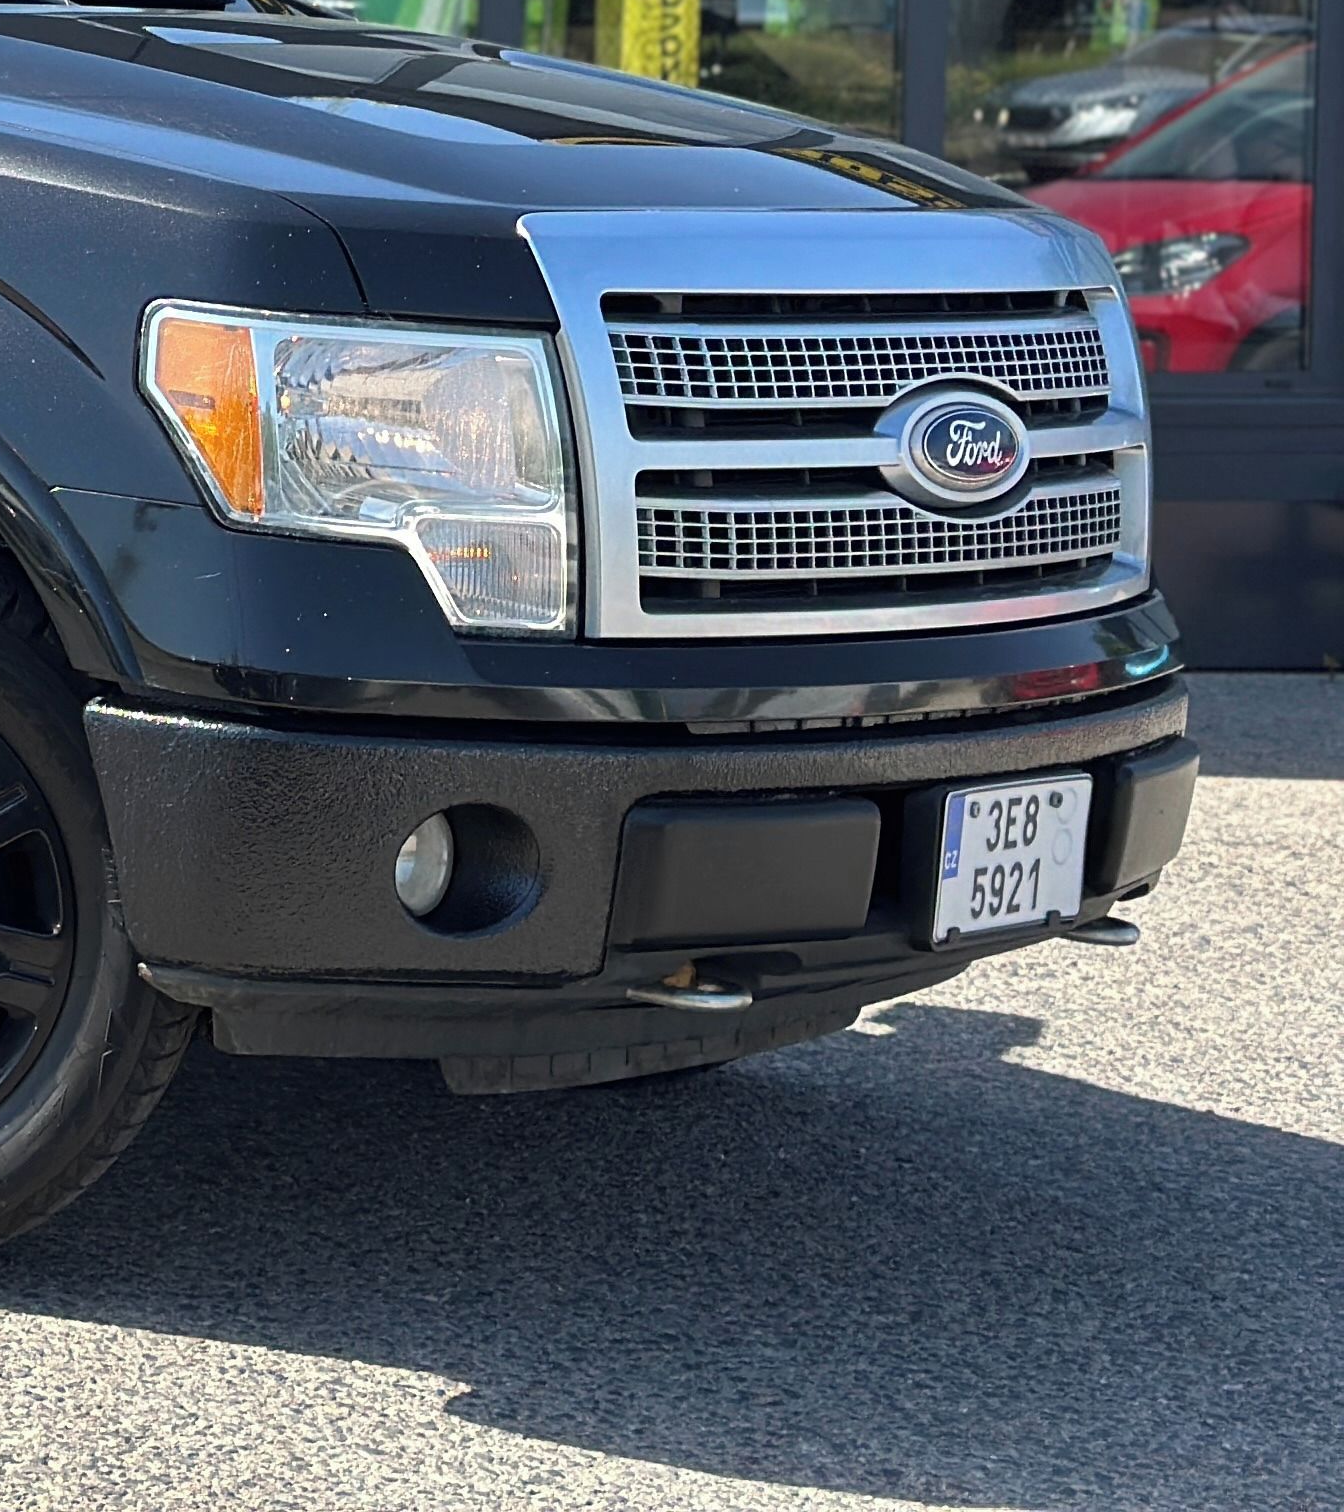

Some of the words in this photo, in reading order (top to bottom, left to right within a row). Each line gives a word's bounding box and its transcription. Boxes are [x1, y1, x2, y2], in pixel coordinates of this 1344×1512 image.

[946, 419, 1003, 467] Ford
[985, 794, 1040, 852] 3E8
[944, 850, 958, 869] CZ
[970, 858, 1041, 919] 5921
